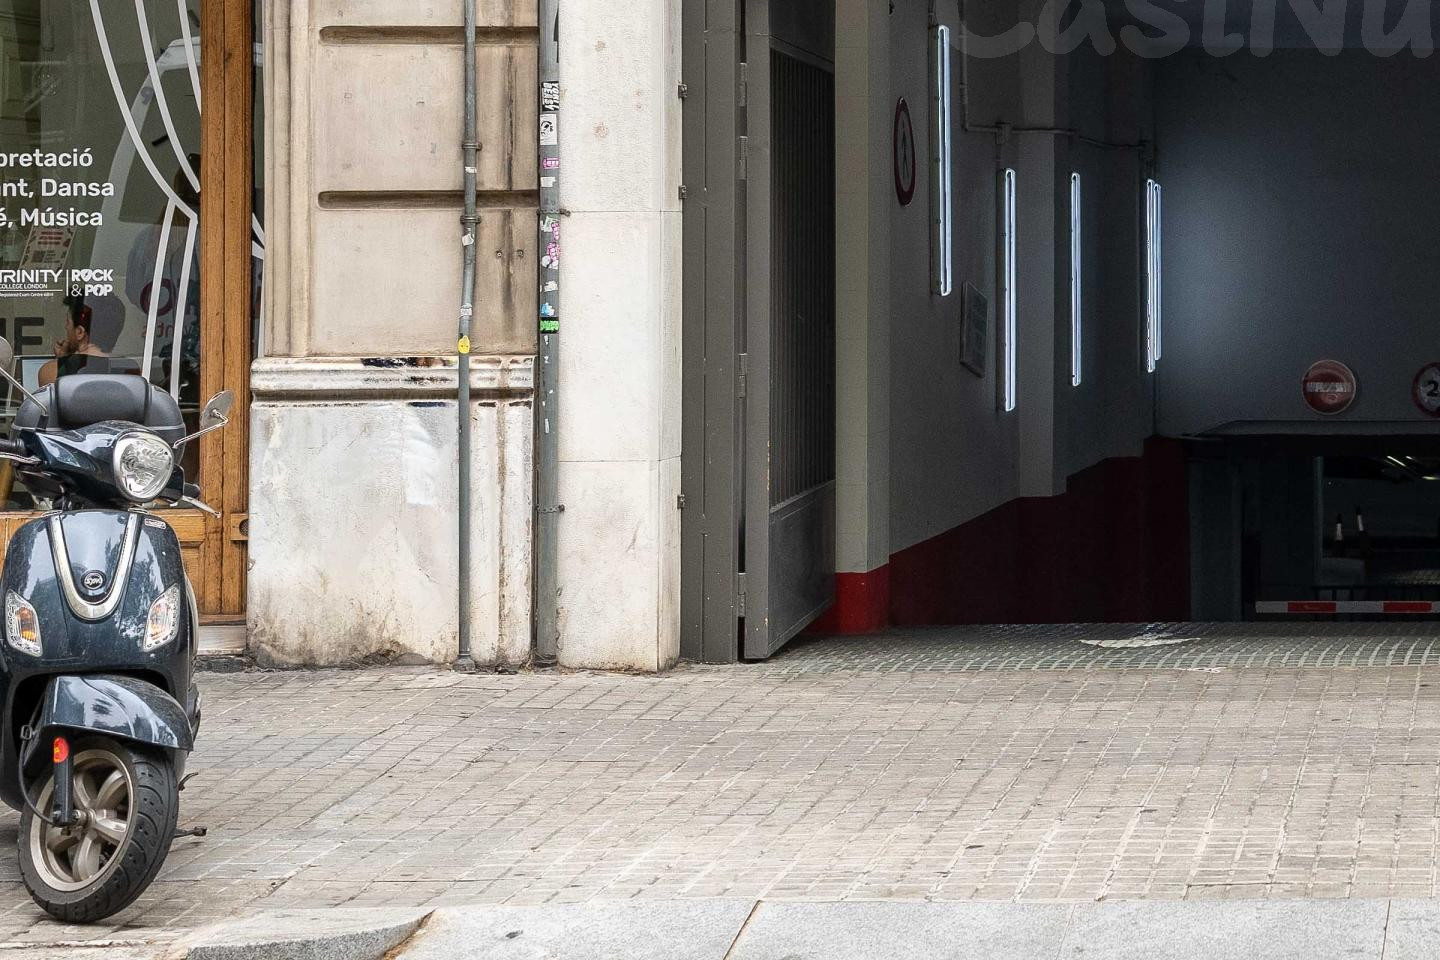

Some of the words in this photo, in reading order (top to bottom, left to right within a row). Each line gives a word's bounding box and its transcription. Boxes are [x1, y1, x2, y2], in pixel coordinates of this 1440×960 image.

[0, 178, 35, 198] nt,
[41, 178, 115, 197] Dansa
[20, 207, 103, 227] Música
[71, 269, 114, 282] ROCK
[71, 283, 82, 297] &
[85, 284, 113, 297] POP
